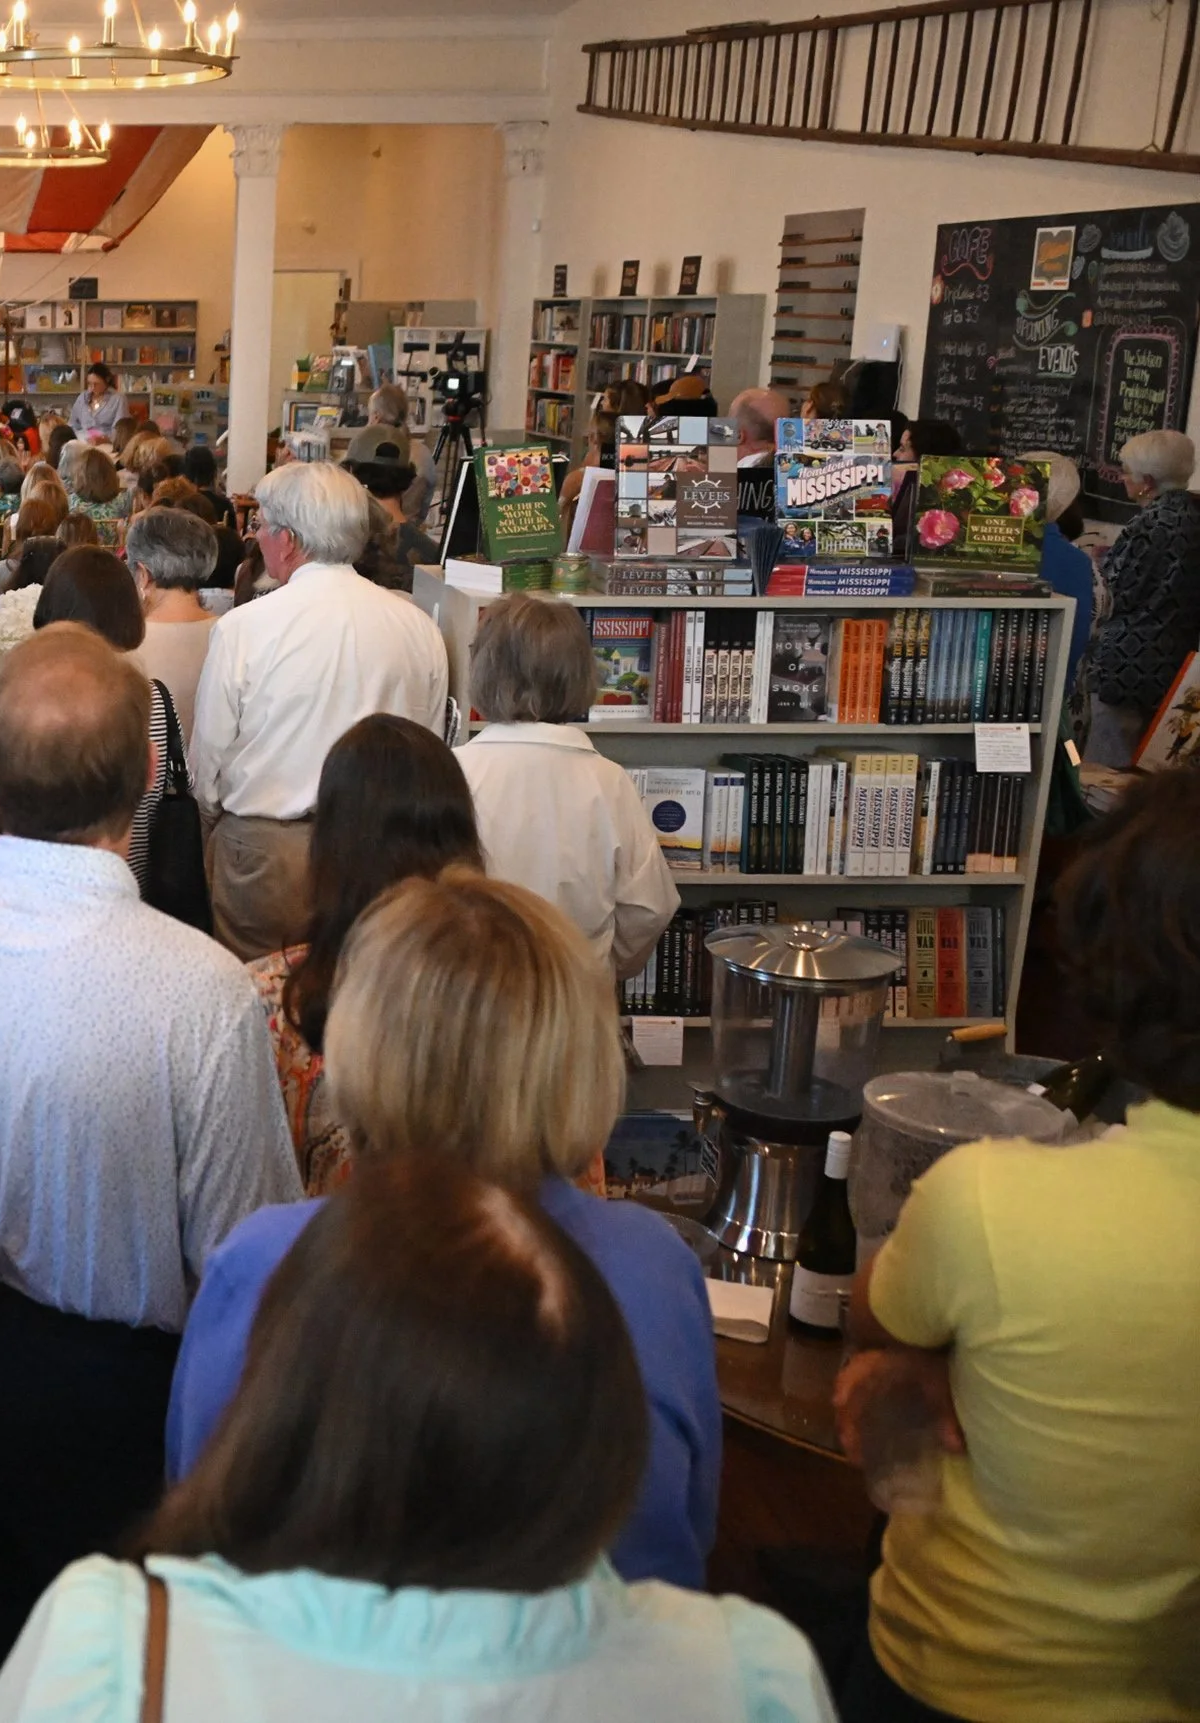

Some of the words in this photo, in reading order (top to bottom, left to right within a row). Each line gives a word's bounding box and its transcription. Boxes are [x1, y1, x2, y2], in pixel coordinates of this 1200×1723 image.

[1038, 344, 1079, 376] EVENTS
[797, 459, 854, 478] Hometown
[787, 464, 884, 506] MISSISSIPPI
[683, 491, 730, 501] LEVEES
[497, 501, 547, 512] SOUTHERN
[499, 515, 549, 527] SOUTHERN
[985, 518, 1007, 526] ONE
[495, 523, 555, 534] LANDSCAPES
[973, 534, 1015, 543] GARDEN
[622, 570, 662, 581] LEVEES
[808, 567, 837, 576] Hometown
[839, 567, 892, 577] MISSISSIPPI
[837, 577, 890, 586] MISSISSIPPI
[621, 584, 662, 595] LEVEES
[836, 587, 889, 596] MISSISSIPPI
[592, 620, 649, 636] ISSISSIPPI
[776, 642, 821, 650] HOUSE
[788, 663, 805, 671] OF
[890, 657, 902, 697] MISSISSIPPI
[902, 659, 914, 698] MISSISSIPPI
[917, 658, 927, 697] MISSISSIPPI
[772, 684, 819, 693] SMOKE
[856, 787, 867, 848] MISSISSIPPI
[872, 787, 883, 848] MISSISSIPPI
[887, 787, 898, 848] MISSISSIPPI
[903, 787, 914, 848] MISSISSIPPI
[916, 919, 934, 934] CIVIL
[916, 936, 934, 949] WAR
